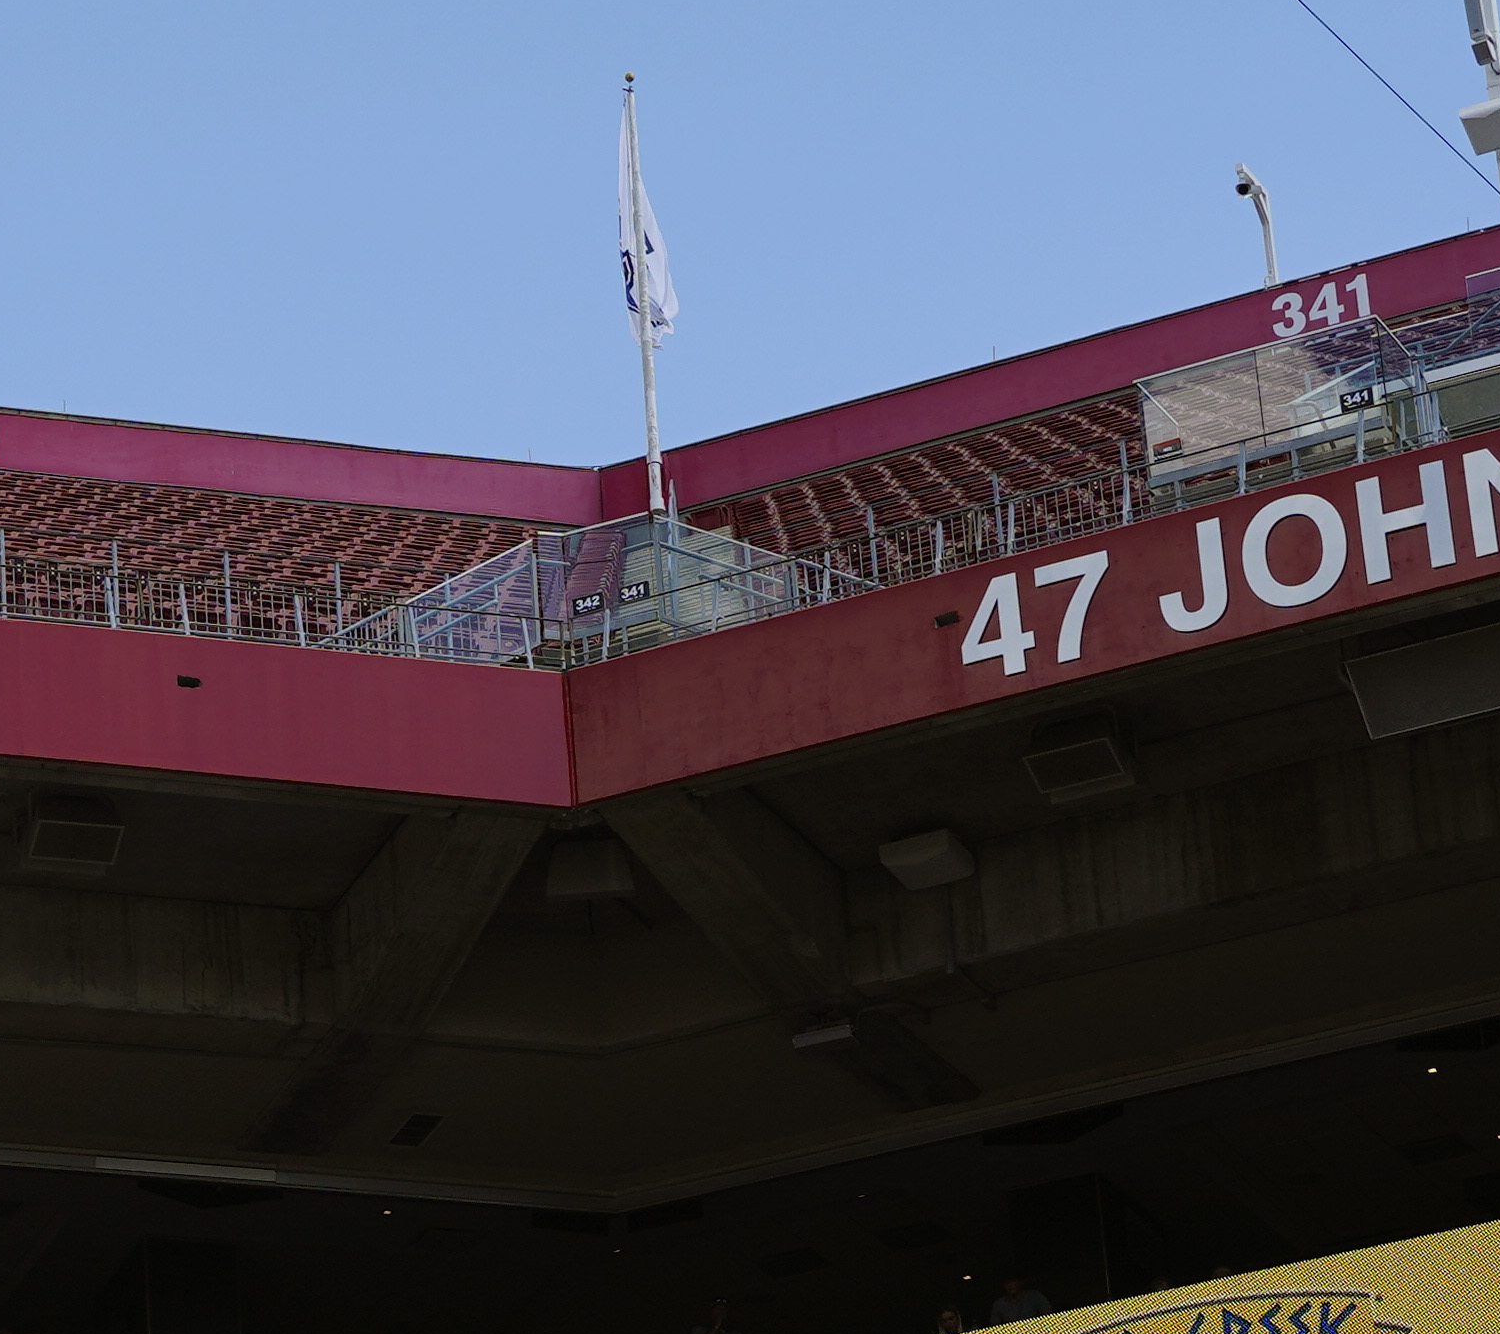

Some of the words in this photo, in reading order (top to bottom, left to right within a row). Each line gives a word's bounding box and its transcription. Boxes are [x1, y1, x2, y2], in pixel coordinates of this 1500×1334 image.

[1271, 273, 1371, 338] 341
[1342, 391, 1370, 407] 341
[620, 583, 645, 600] 341
[576, 595, 600, 610] 342
[961, 550, 1110, 676] 47
